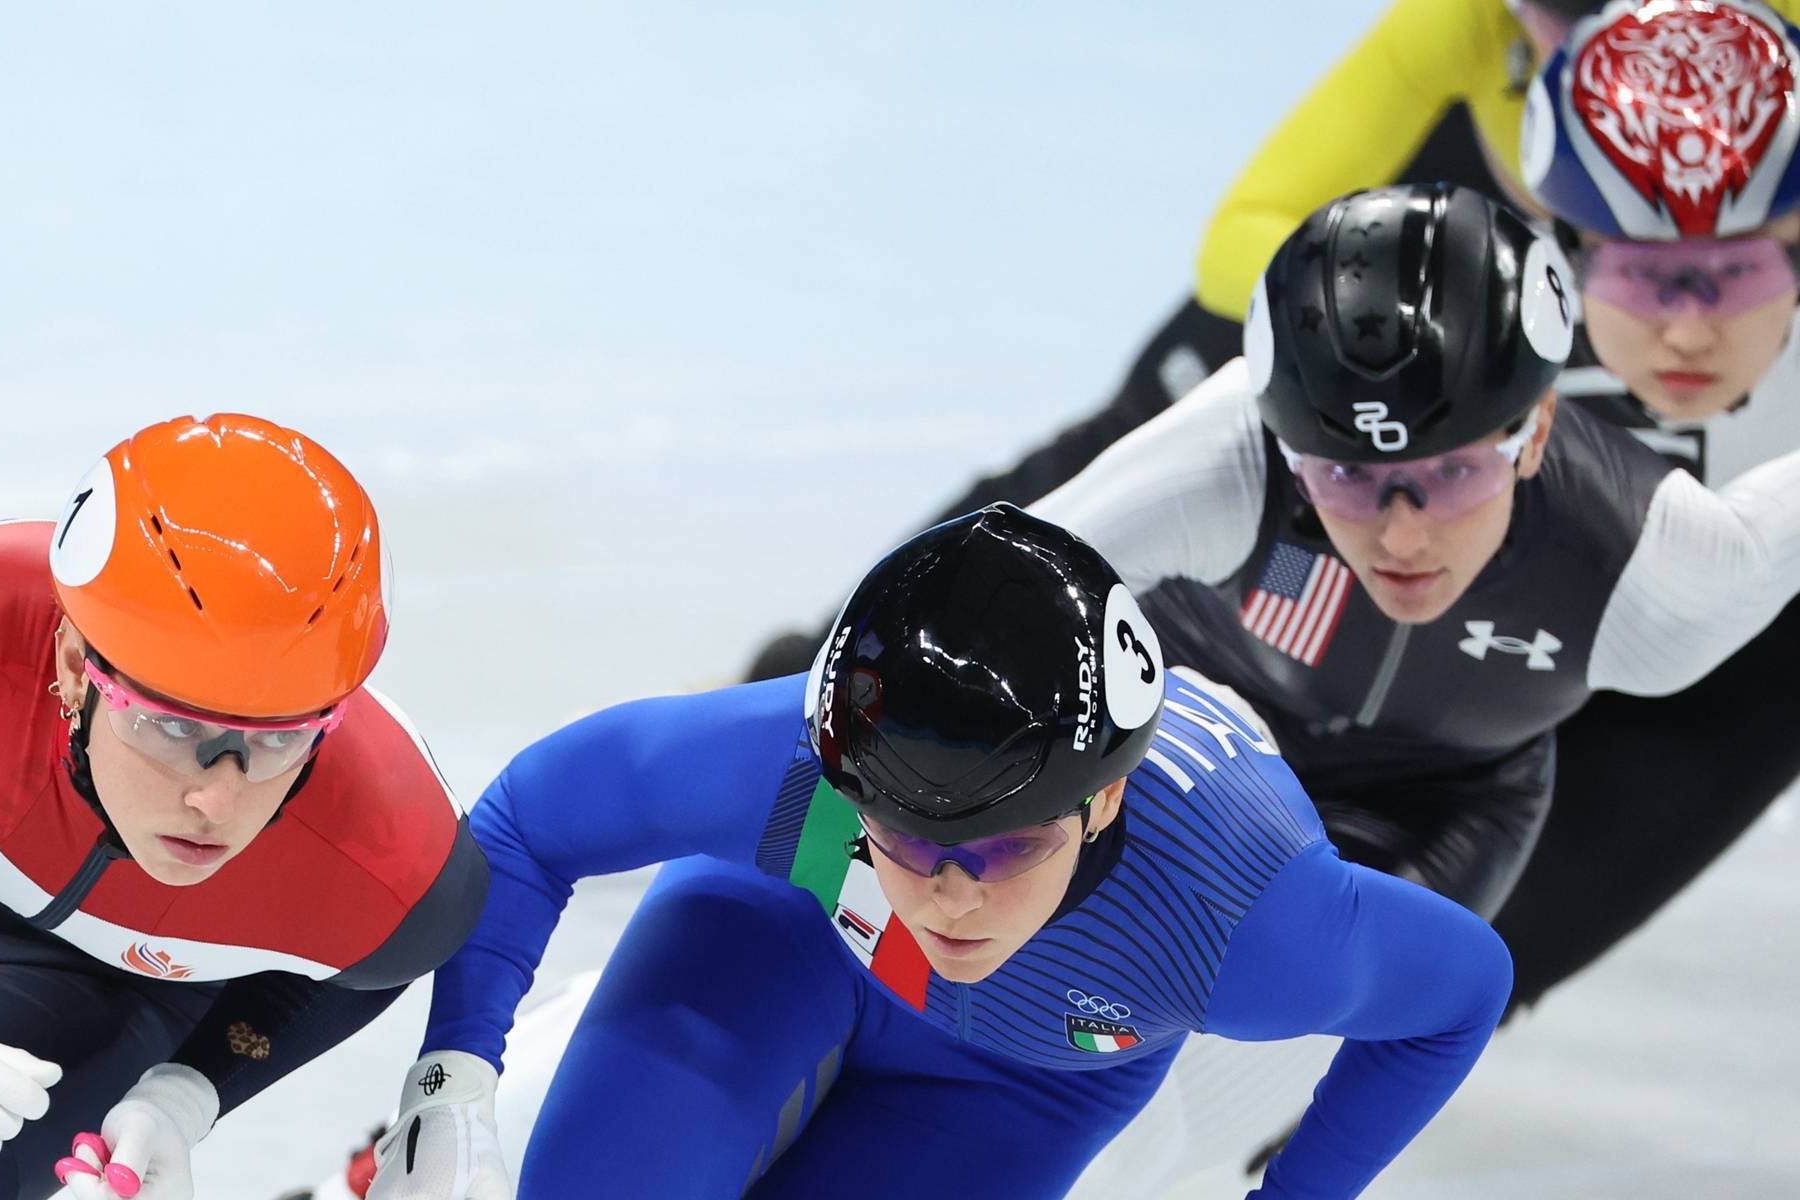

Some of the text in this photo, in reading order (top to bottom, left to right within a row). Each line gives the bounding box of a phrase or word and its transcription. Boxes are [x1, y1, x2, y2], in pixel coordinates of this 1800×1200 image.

[58, 487, 94, 550] 1
[1117, 619, 1156, 684] 3
[1073, 636, 1092, 751] RUDY
[1071, 1018, 1130, 1034] ITALIA
